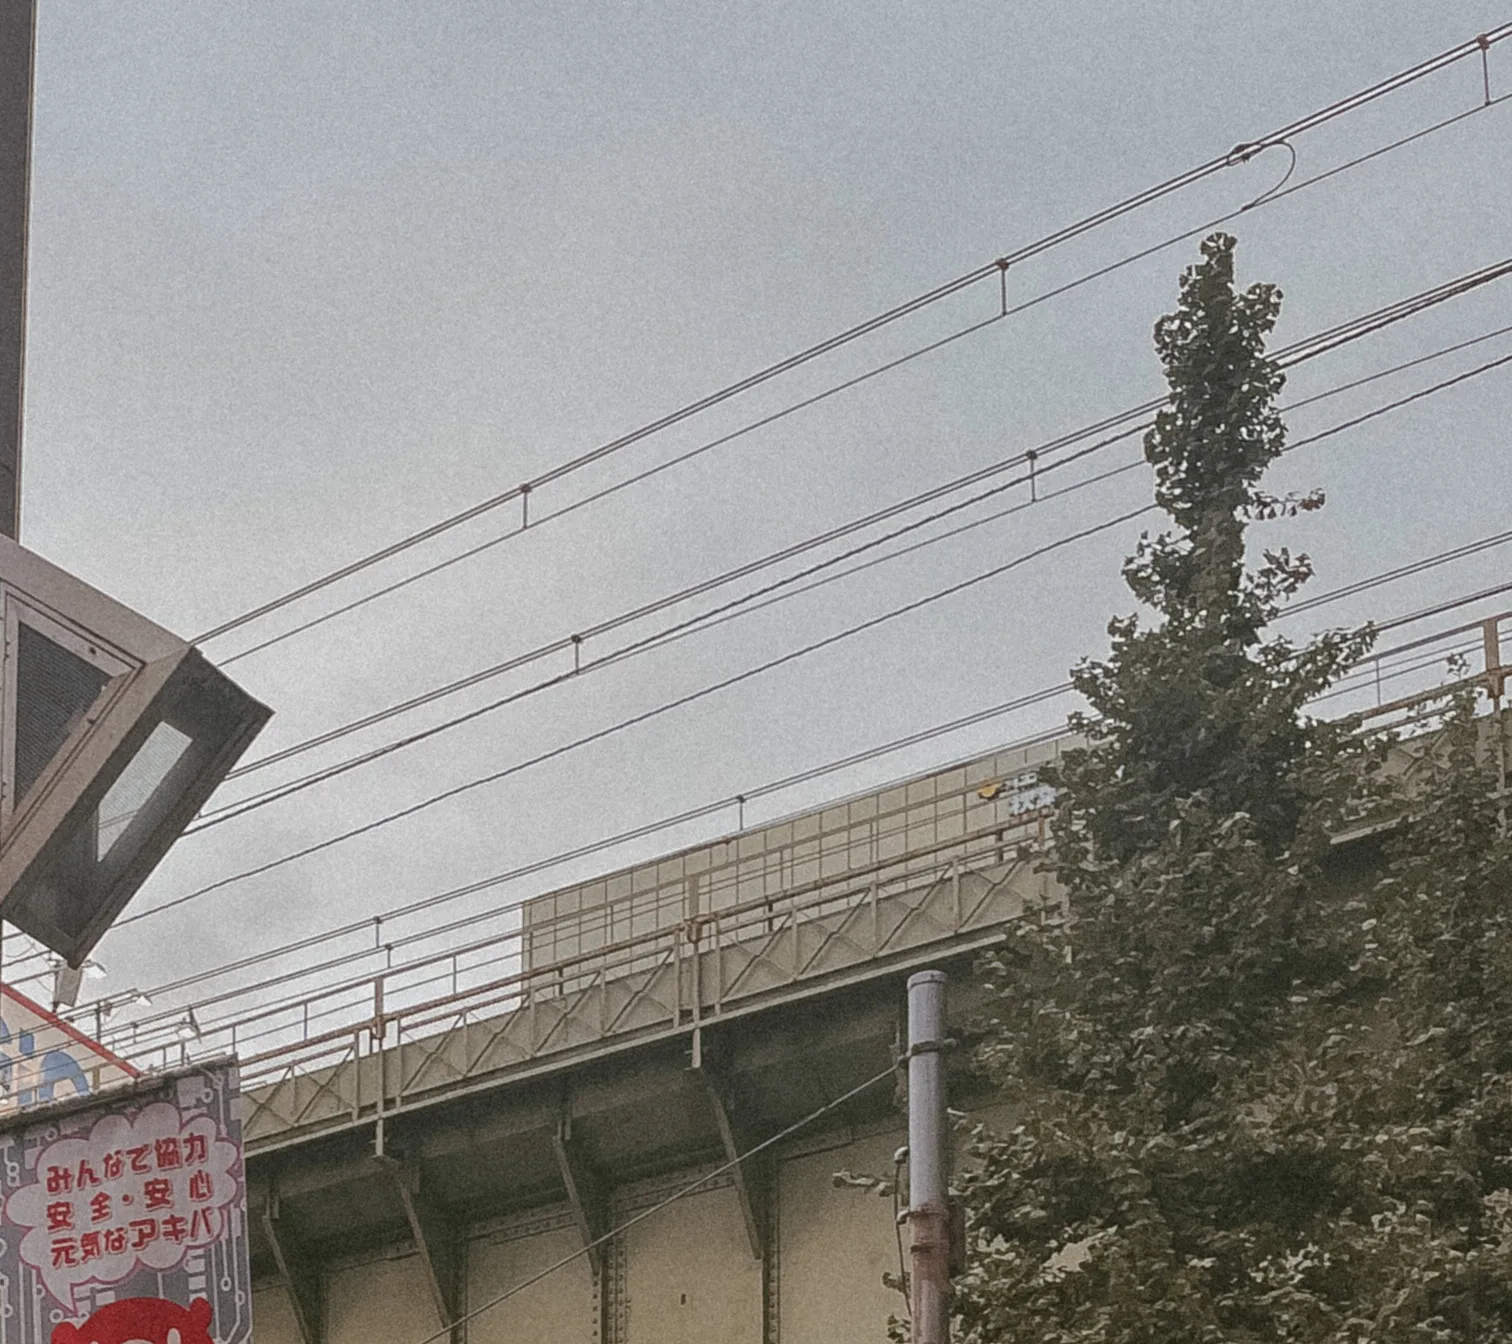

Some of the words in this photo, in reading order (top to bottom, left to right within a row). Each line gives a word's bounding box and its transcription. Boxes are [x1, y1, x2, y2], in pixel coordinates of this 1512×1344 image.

[46, 1132, 207, 1193] みんなで協力
[50, 1207, 213, 1267] 元気なアキバ
